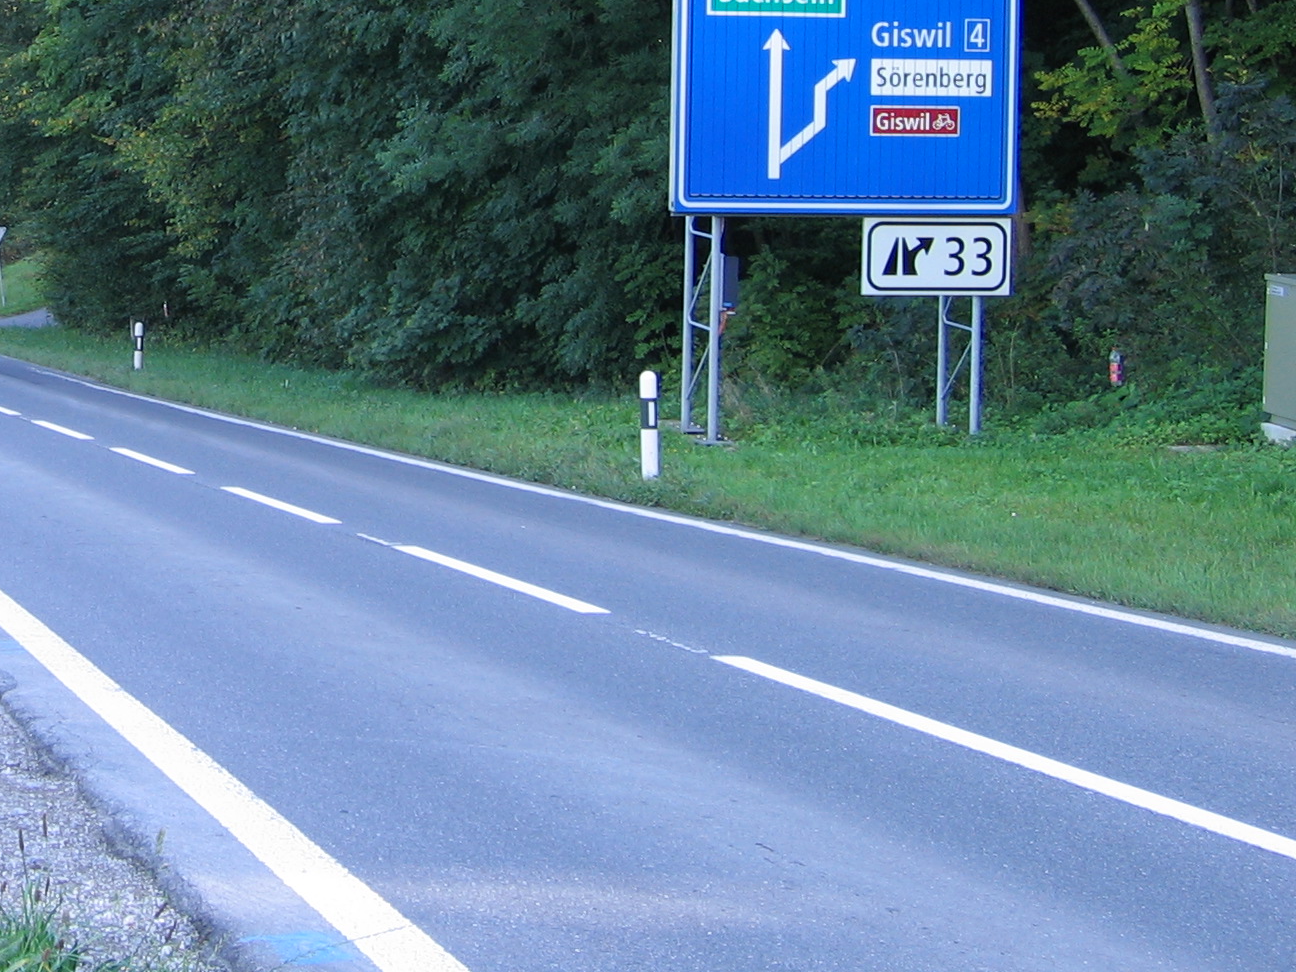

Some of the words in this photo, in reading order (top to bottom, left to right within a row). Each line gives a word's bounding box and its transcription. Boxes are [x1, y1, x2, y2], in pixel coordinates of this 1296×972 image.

[871, 21, 952, 48] Giswil
[969, 22, 986, 48] 4
[876, 66, 988, 94] Sörenberg
[875, 112, 931, 131] Giswil
[943, 236, 994, 276] 33
